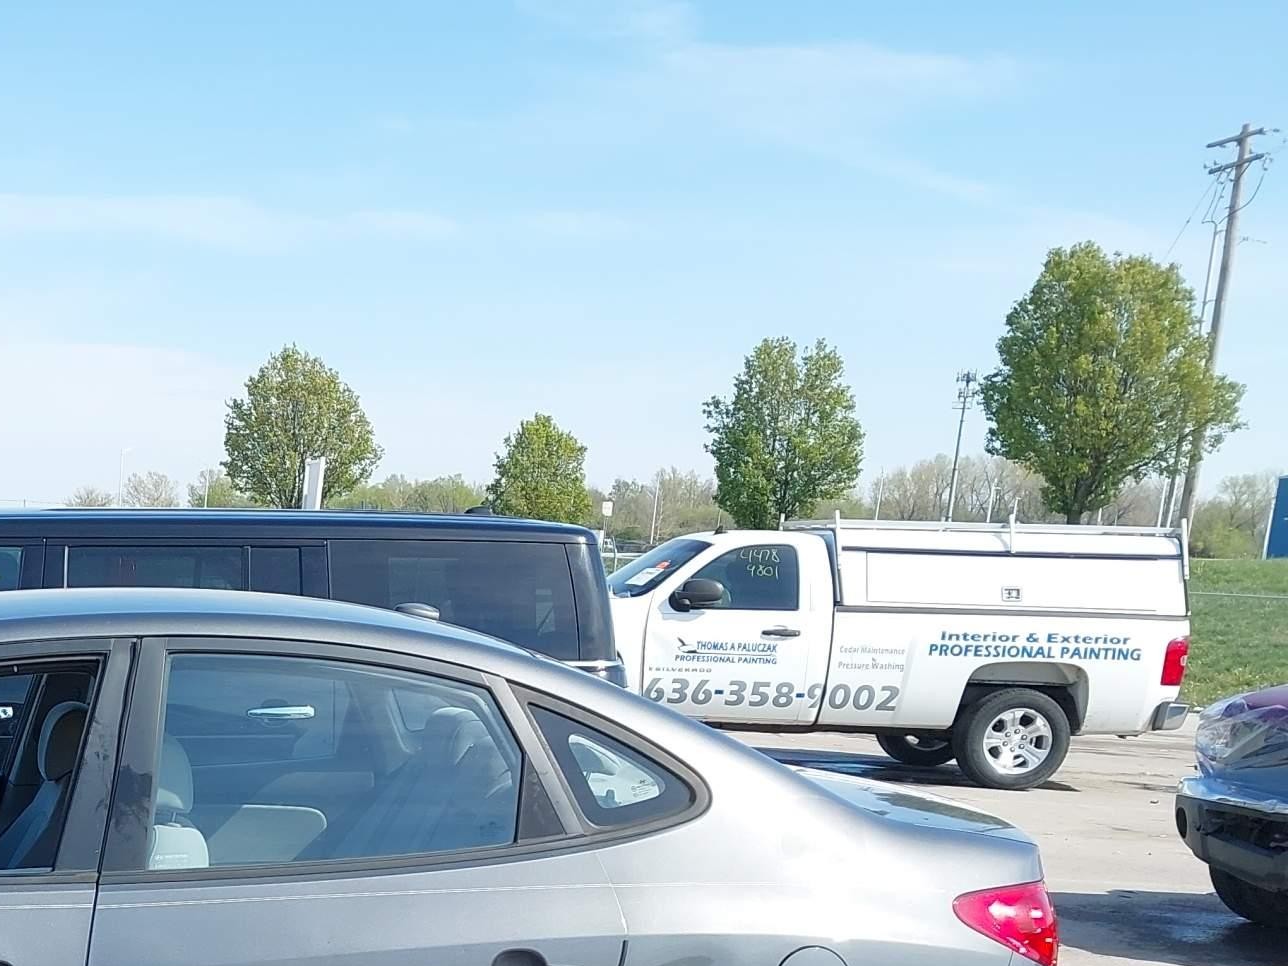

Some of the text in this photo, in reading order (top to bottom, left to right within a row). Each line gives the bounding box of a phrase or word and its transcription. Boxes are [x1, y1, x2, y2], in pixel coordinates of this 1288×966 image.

[740, 548, 780, 563] 4478
[746, 564, 779, 580] 9801
[940, 631, 1130, 645] Interior & Exterior
[696, 641, 778, 653] THOMAS A PALUCZAK
[860, 646, 905, 655] Maintenance
[928, 643, 1142, 661] PROFESSIONAL PAINTING
[675, 654, 778, 665] PROFESSIONAL PAINTING
[838, 661, 905, 672] Pressure Washing
[643, 678, 900, 712] 636-358-9002
